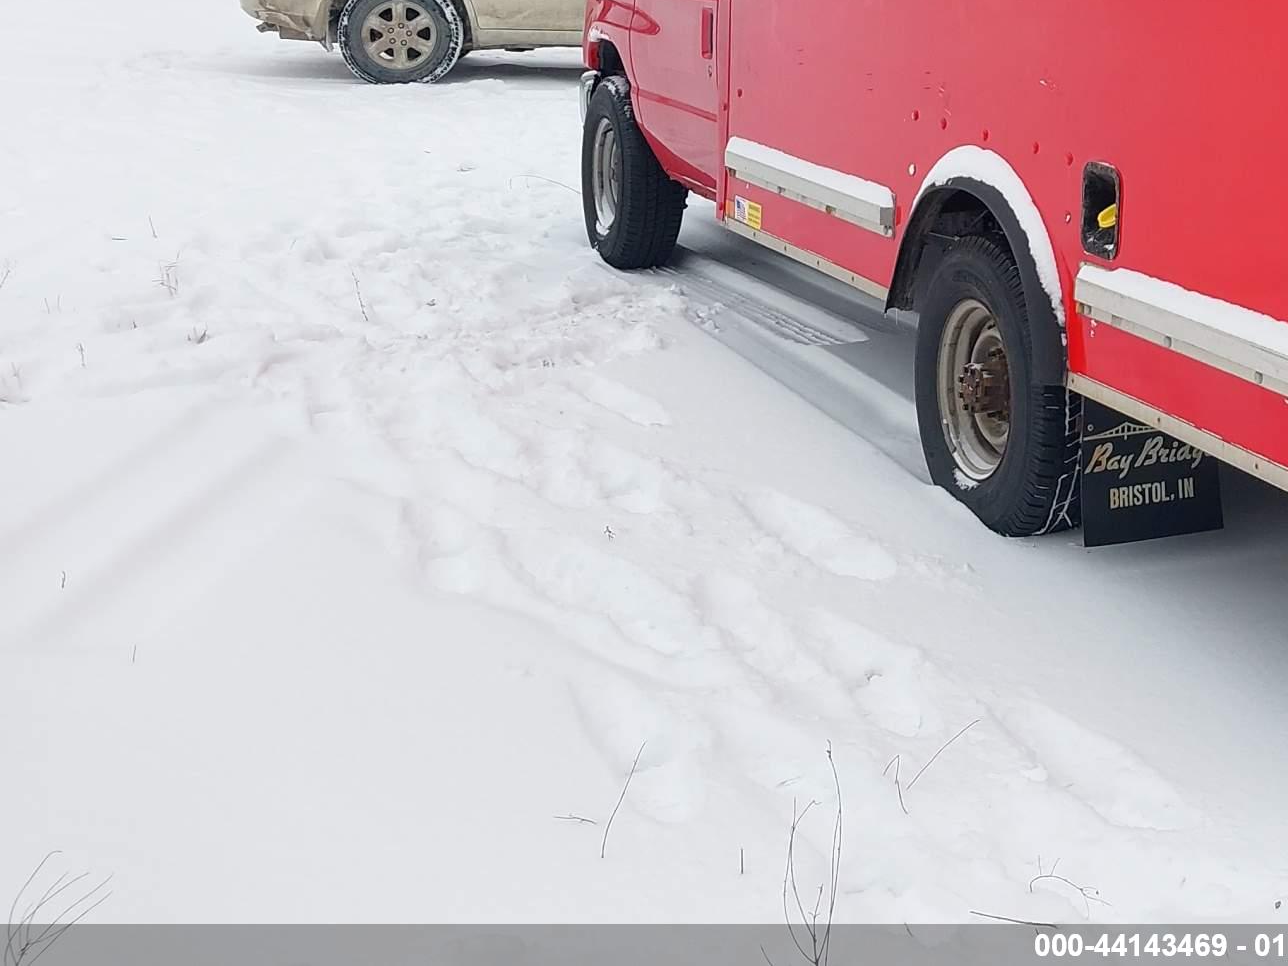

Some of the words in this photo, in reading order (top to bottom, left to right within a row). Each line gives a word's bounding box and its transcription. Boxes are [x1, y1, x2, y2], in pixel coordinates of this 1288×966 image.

[1084, 441, 1135, 479] Bay
[1109, 481, 1175, 510] BRISTOL,
[1177, 476, 1195, 499] IN
